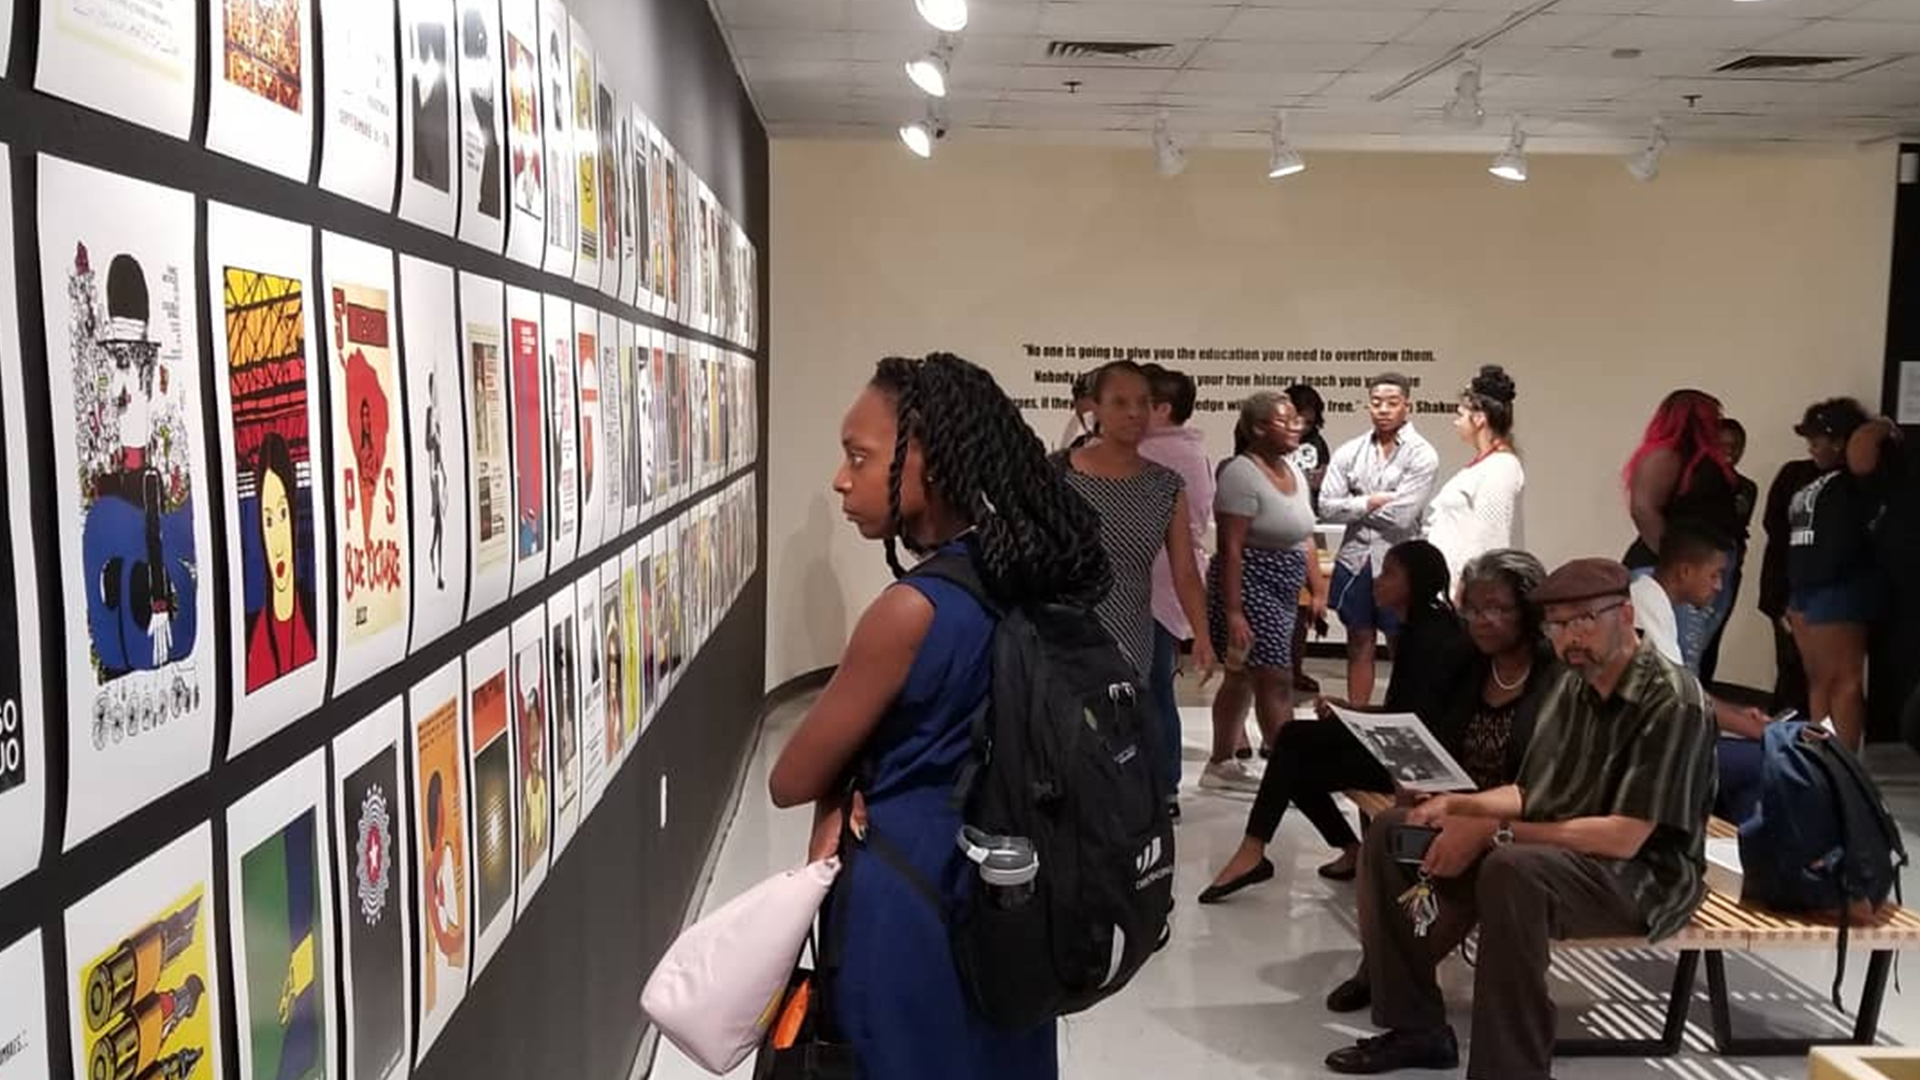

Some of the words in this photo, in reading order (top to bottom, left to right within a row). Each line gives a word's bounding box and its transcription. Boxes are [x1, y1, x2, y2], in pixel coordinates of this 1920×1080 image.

[1043, 347, 1064, 358] one
[1066, 345, 1076, 358] is
[1078, 346, 1111, 360] going
[1113, 347, 1124, 359] to
[1127, 347, 1150, 361] give
[1153, 349, 1174, 361] you
[1177, 347, 1196, 360] the
[1198, 348, 1259, 361] education
[1261, 349, 1284, 362] you
[1286, 349, 1317, 361] need
[1320, 349, 1332, 361] to
[1335, 348, 1399, 362] overthrow
[1401, 349, 1436, 362] them.
[1034, 370, 1075, 384] Nobody
[1197, 375, 1223, 387] your
[1226, 375, 1251, 387] true
[1302, 375, 1336, 387] teach
[1339, 376, 1361, 388] you
[1041, 396, 1049, 410] if
